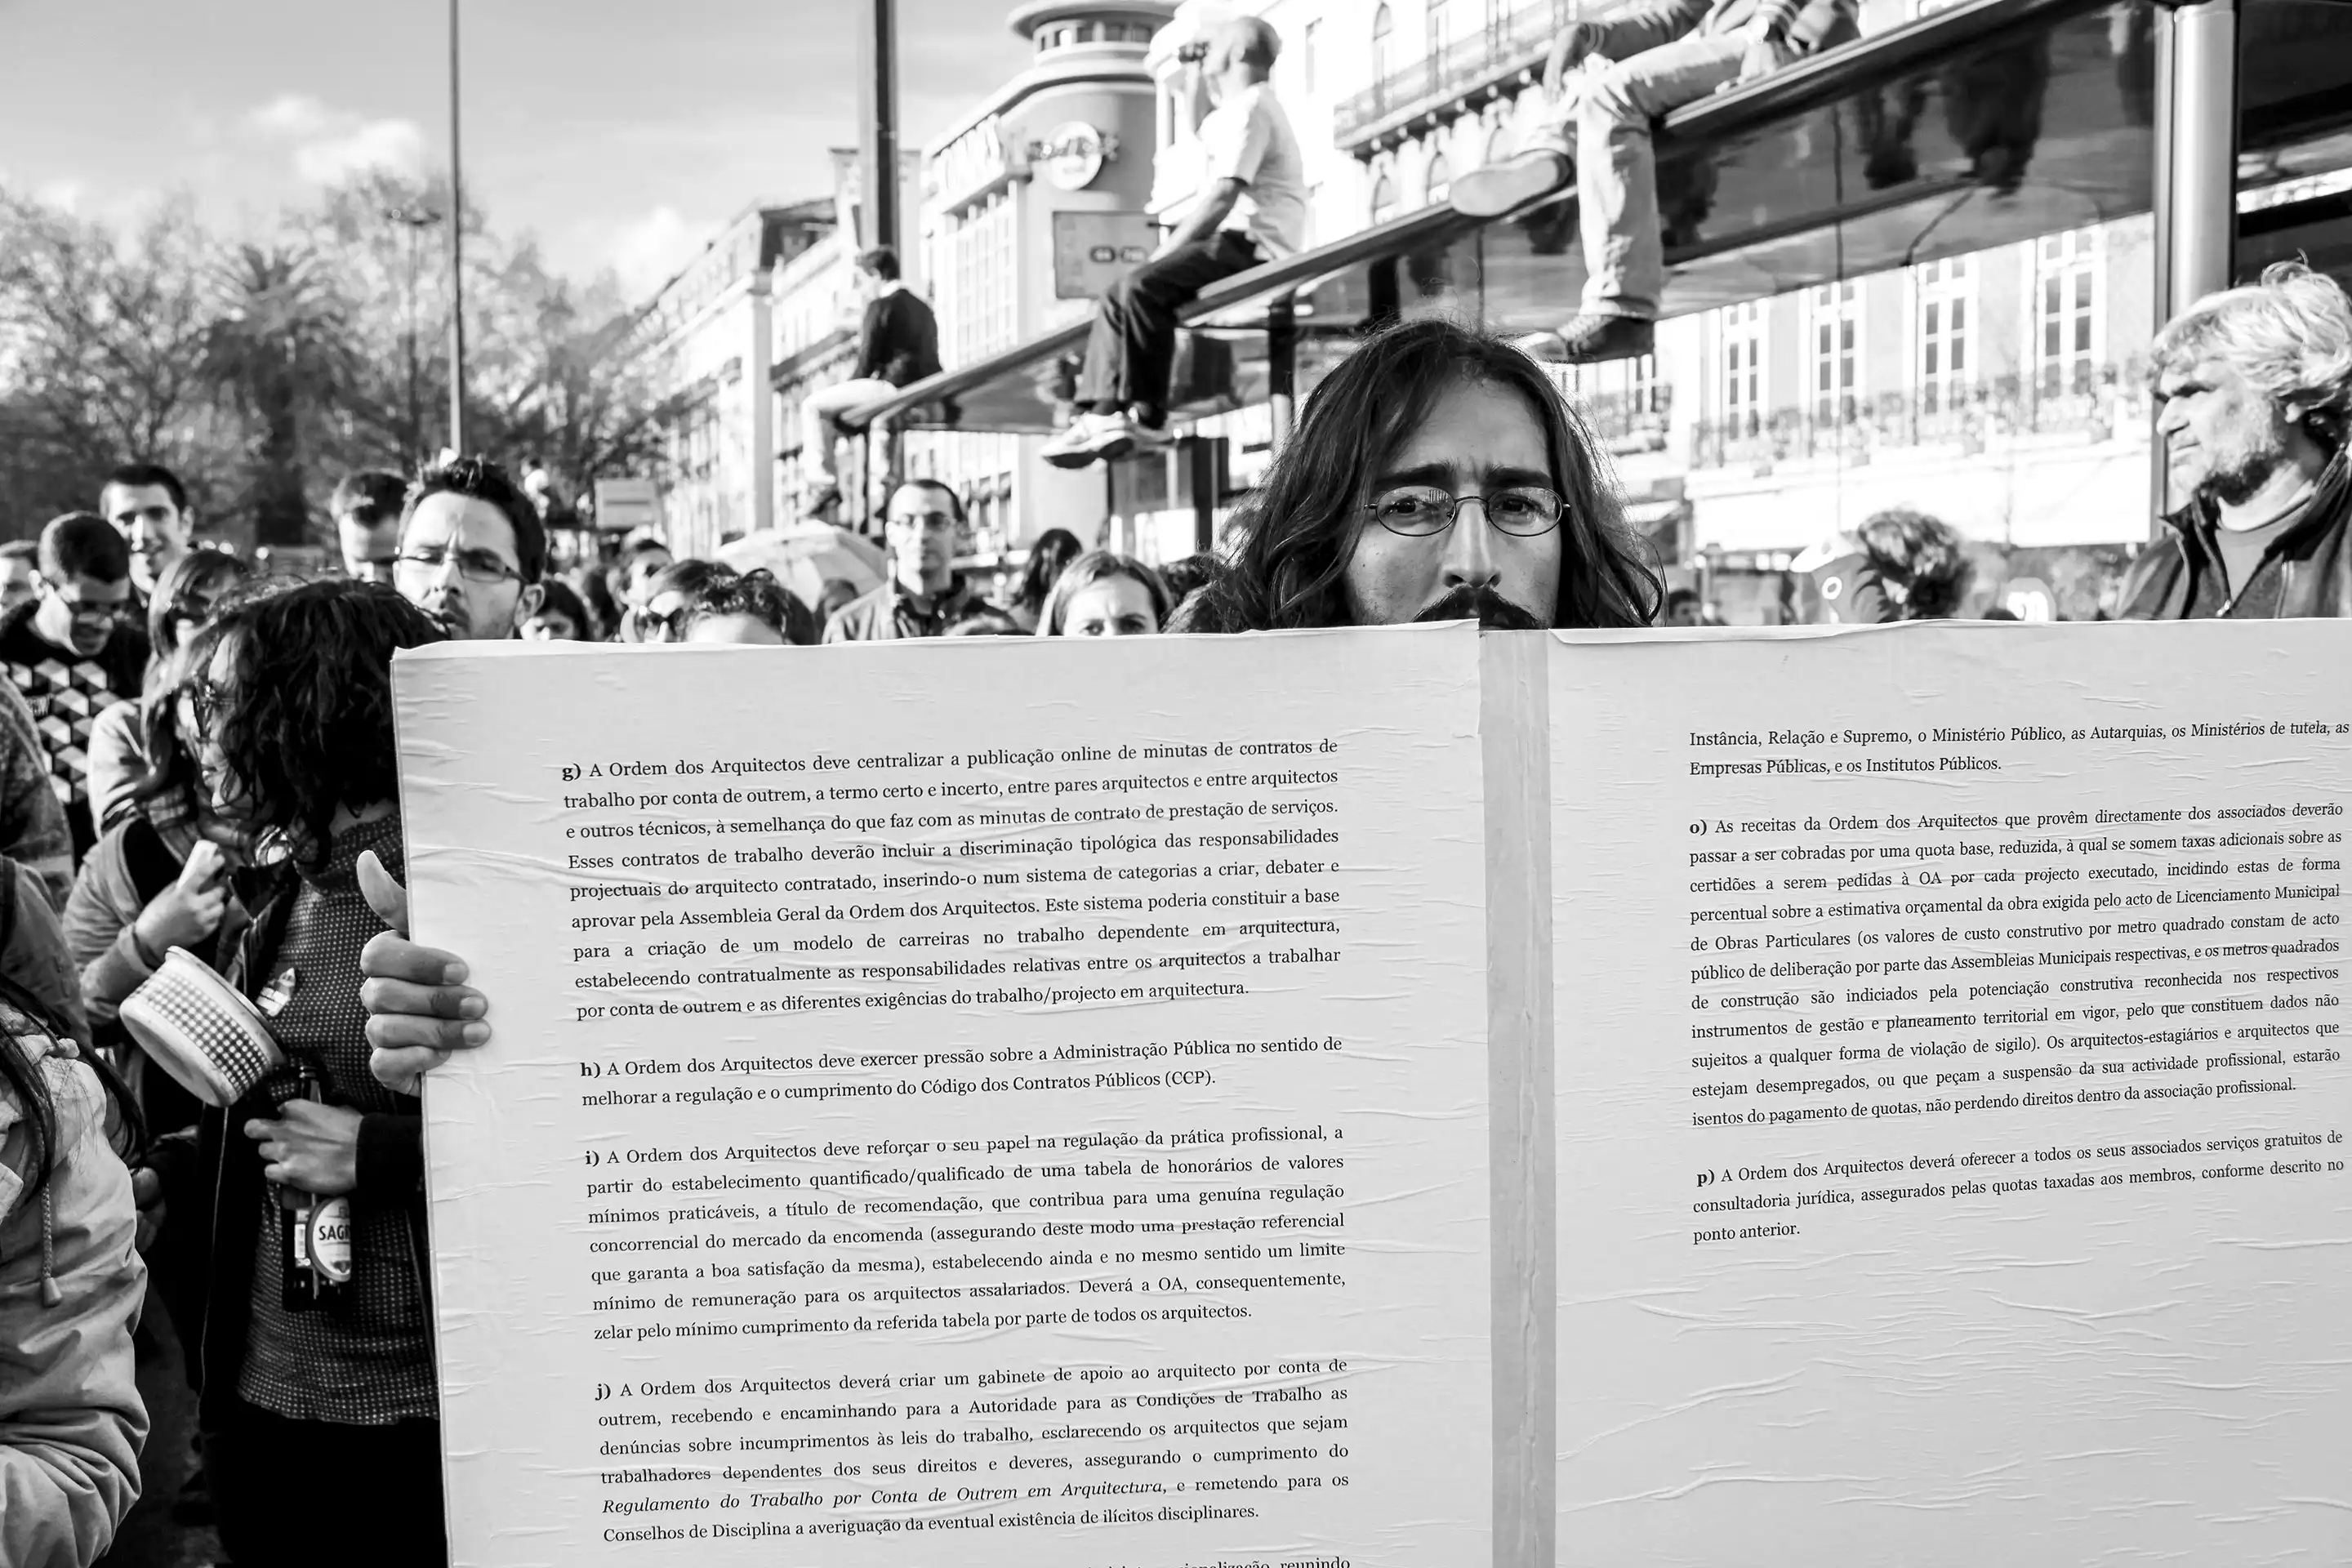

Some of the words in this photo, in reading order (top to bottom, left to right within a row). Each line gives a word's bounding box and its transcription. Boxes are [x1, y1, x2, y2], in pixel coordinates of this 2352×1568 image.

[1690, 730, 1762, 748] Instância,
[1767, 729, 1825, 748] Relação
[1829, 733, 1838, 744] e
[1843, 729, 1913, 747] Supremo,
[1918, 732, 1927, 742] o
[1931, 727, 2006, 742] Ministério
[2010, 726, 2066, 742] Público,
[2070, 729, 2086, 740] as
[2089, 724, 2167, 742] Autarquias,
[2172, 727, 2186, 737] os
[2190, 721, 2265, 737] Ministérios
[2270, 720, 2286, 735] de
[2290, 719, 2331, 737] tutela,
[2335, 723, 2350, 734] as
[562, 763, 581, 782] g)
[589, 763, 604, 777] A
[609, 760, 668, 777] Ordem
[675, 759, 704, 775] dos
[710, 757, 806, 777] Arquitectos
[813, 755, 850, 771] deve
[857, 751, 945, 769] centralizar
[951, 755, 960, 766] a
[967, 748, 1054, 769] publicação
[1061, 746, 1111, 762] online
[1117, 744, 1137, 760] de
[1143, 743, 1208, 759] minutas
[1214, 741, 1233, 757] de
[1239, 742, 1312, 755] contratos
[1319, 737, 1338, 753] de
[568, 854, 614, 869] Esses
[621, 852, 700, 867] contratos
[707, 849, 728, 864] de
[734, 846, 804, 863] trabalho
[810, 844, 875, 861] deverão
[882, 842, 935, 858] incluir
[942, 846, 952, 857] a
[960, 837, 1073, 857] discriminação
[1080, 834, 1157, 854] tipológica
[1165, 832, 1192, 849] das
[1198, 827, 1339, 850] responsabilidades
[1690, 936, 1708, 951] de
[1715, 935, 1759, 951] Obras
[1765, 931, 1851, 948] Particulares
[1857, 930, 1879, 947] (os
[1884, 928, 1936, 943] valores
[1941, 926, 1958, 942] de
[1964, 927, 2001, 941] custo
[2007, 922, 2083, 939] construtivo
[2088, 924, 2112, 939] por
[2117, 920, 2157, 934] metro
[2162, 915, 2225, 935] quadrado
[2230, 915, 2285, 929] constam
[2291, 911, 2307, 926] de
[2312, 913, 2340, 925] acto
[576, 1006, 606, 1022] por
[609, 1003, 655, 1017] conta
[658, 1000, 679, 1015] de
[682, 1000, 742, 1014] outrem
[746, 1001, 755, 1012] e
[760, 1000, 777, 1012] as
[781, 995, 862, 1011] diferentes
[865, 991, 947, 1010] exigências
[951, 989, 972, 1004] do
[975, 985, 1116, 1005] trabalho/projecto
[1120, 987, 1144, 999] em
[1148, 982, 1250, 1000] arquitectura.
[581, 1090, 658, 1107] melhorar
[662, 1092, 671, 1103] a
[675, 1086, 753, 1106] regulação
[757, 1089, 767, 1100] e
[770, 1089, 781, 1099] o
[784, 1082, 893, 1102] cumprimento
[896, 1080, 917, 1095] do
[920, 1078, 977, 1097] Código
[981, 1076, 1009, 1092] dos
[1013, 1076, 1091, 1091] Contratos
[1094, 1071, 1160, 1088] Públicos
[1165, 1069, 1216, 1088] (CCP).
[1692, 1081, 1748, 1099] estejam
[1756, 1074, 1869, 1095] desempregados,
[1877, 1076, 1895, 1087] ou
[1902, 1074, 1928, 1089] que
[1936, 1071, 1980, 1087] peçam
[1987, 1071, 1996, 1081] a
[2002, 1062, 2073, 1082] suspensão
[2078, 1061, 2096, 1076] da
[2101, 1062, 2125, 1074] sua
[2132, 1054, 2198, 1072] actividade
[2205, 1049, 2286, 1071] profissional,
[2292, 1048, 2341, 1063] estarão
[588, 1208, 660, 1224] mínimos
[668, 1203, 760, 1224] praticáveis,
[768, 1206, 777, 1218] a
[785, 1200, 829, 1217] título
[836, 1200, 856, 1215] de
[864, 1196, 983, 1214] recomendação,
[991, 1197, 1021, 1213] que
[1029, 1191, 1105, 1208] contribua
[1112, 1193, 1148, 1209] para
[1156, 1192, 1191, 1204] uma
[1199, 1186, 1261, 1206] genuína
[1269, 1183, 1344, 1203] regulação
[1693, 1192, 1791, 1214] consultadoria
[1795, 1189, 1855, 1209] jurídica,
[1860, 1183, 1945, 1203] assegurados
[1950, 1179, 1987, 1199] pelas
[1992, 1178, 2038, 1196] quotas
[2042, 1173, 2095, 1189] taxadas
[2100, 1174, 2123, 1186] aos
[2128, 1167, 2196, 1183] membros,
[2201, 1163, 2265, 1179] conforme
[2270, 1159, 2322, 1175] descrito
[2327, 1160, 2345, 1171] no
[592, 1295, 656, 1311] mínimo
[664, 1293, 684, 1308] de
[691, 1290, 797, 1308] remuneração
[804, 1292, 840, 1307] para
[848, 1290, 866, 1303] os
[873, 1285, 961, 1304] arquitectos
[969, 1280, 1070, 1298] assalariados.
[1078, 1277, 1134, 1294] Deverá
[1141, 1281, 1150, 1292] a
[1158, 1276, 1187, 1293] OA,
[1196, 1272, 1346, 1292] consequentemente,
[598, 1413, 662, 1428] outrem,
[670, 1406, 753, 1424] recebendo
[762, 1410, 771, 1421] e
[780, 1402, 897, 1420] encaminhando
[906, 1405, 941, 1420] para
[951, 1404, 960, 1414] a
[968, 1396, 1058, 1414] Autoridade
[1066, 1398, 1102, 1414] para
[1111, 1397, 1127, 1409] as
[1136, 1392, 1216, 1409] Condições
[1224, 1390, 1243, 1404] de
[1251, 1386, 1322, 1403] Trabalho
[1330, 1389, 1348, 1401] as
[604, 1525, 685, 1543] Conselhos
[688, 1523, 708, 1539] de
[711, 1521, 791, 1540] Disciplina
[795, 1524, 804, 1535] a
[808, 1518, 902, 1536] averiguação
[905, 1517, 924, 1531] da
[928, 1512, 995, 1530] eventual
[998, 1511, 1076, 1527] existência
[1080, 1509, 1099, 1525] de
[1102, 1508, 1154, 1523] ilícitos
[1157, 1504, 1259, 1523] disciplinares.
